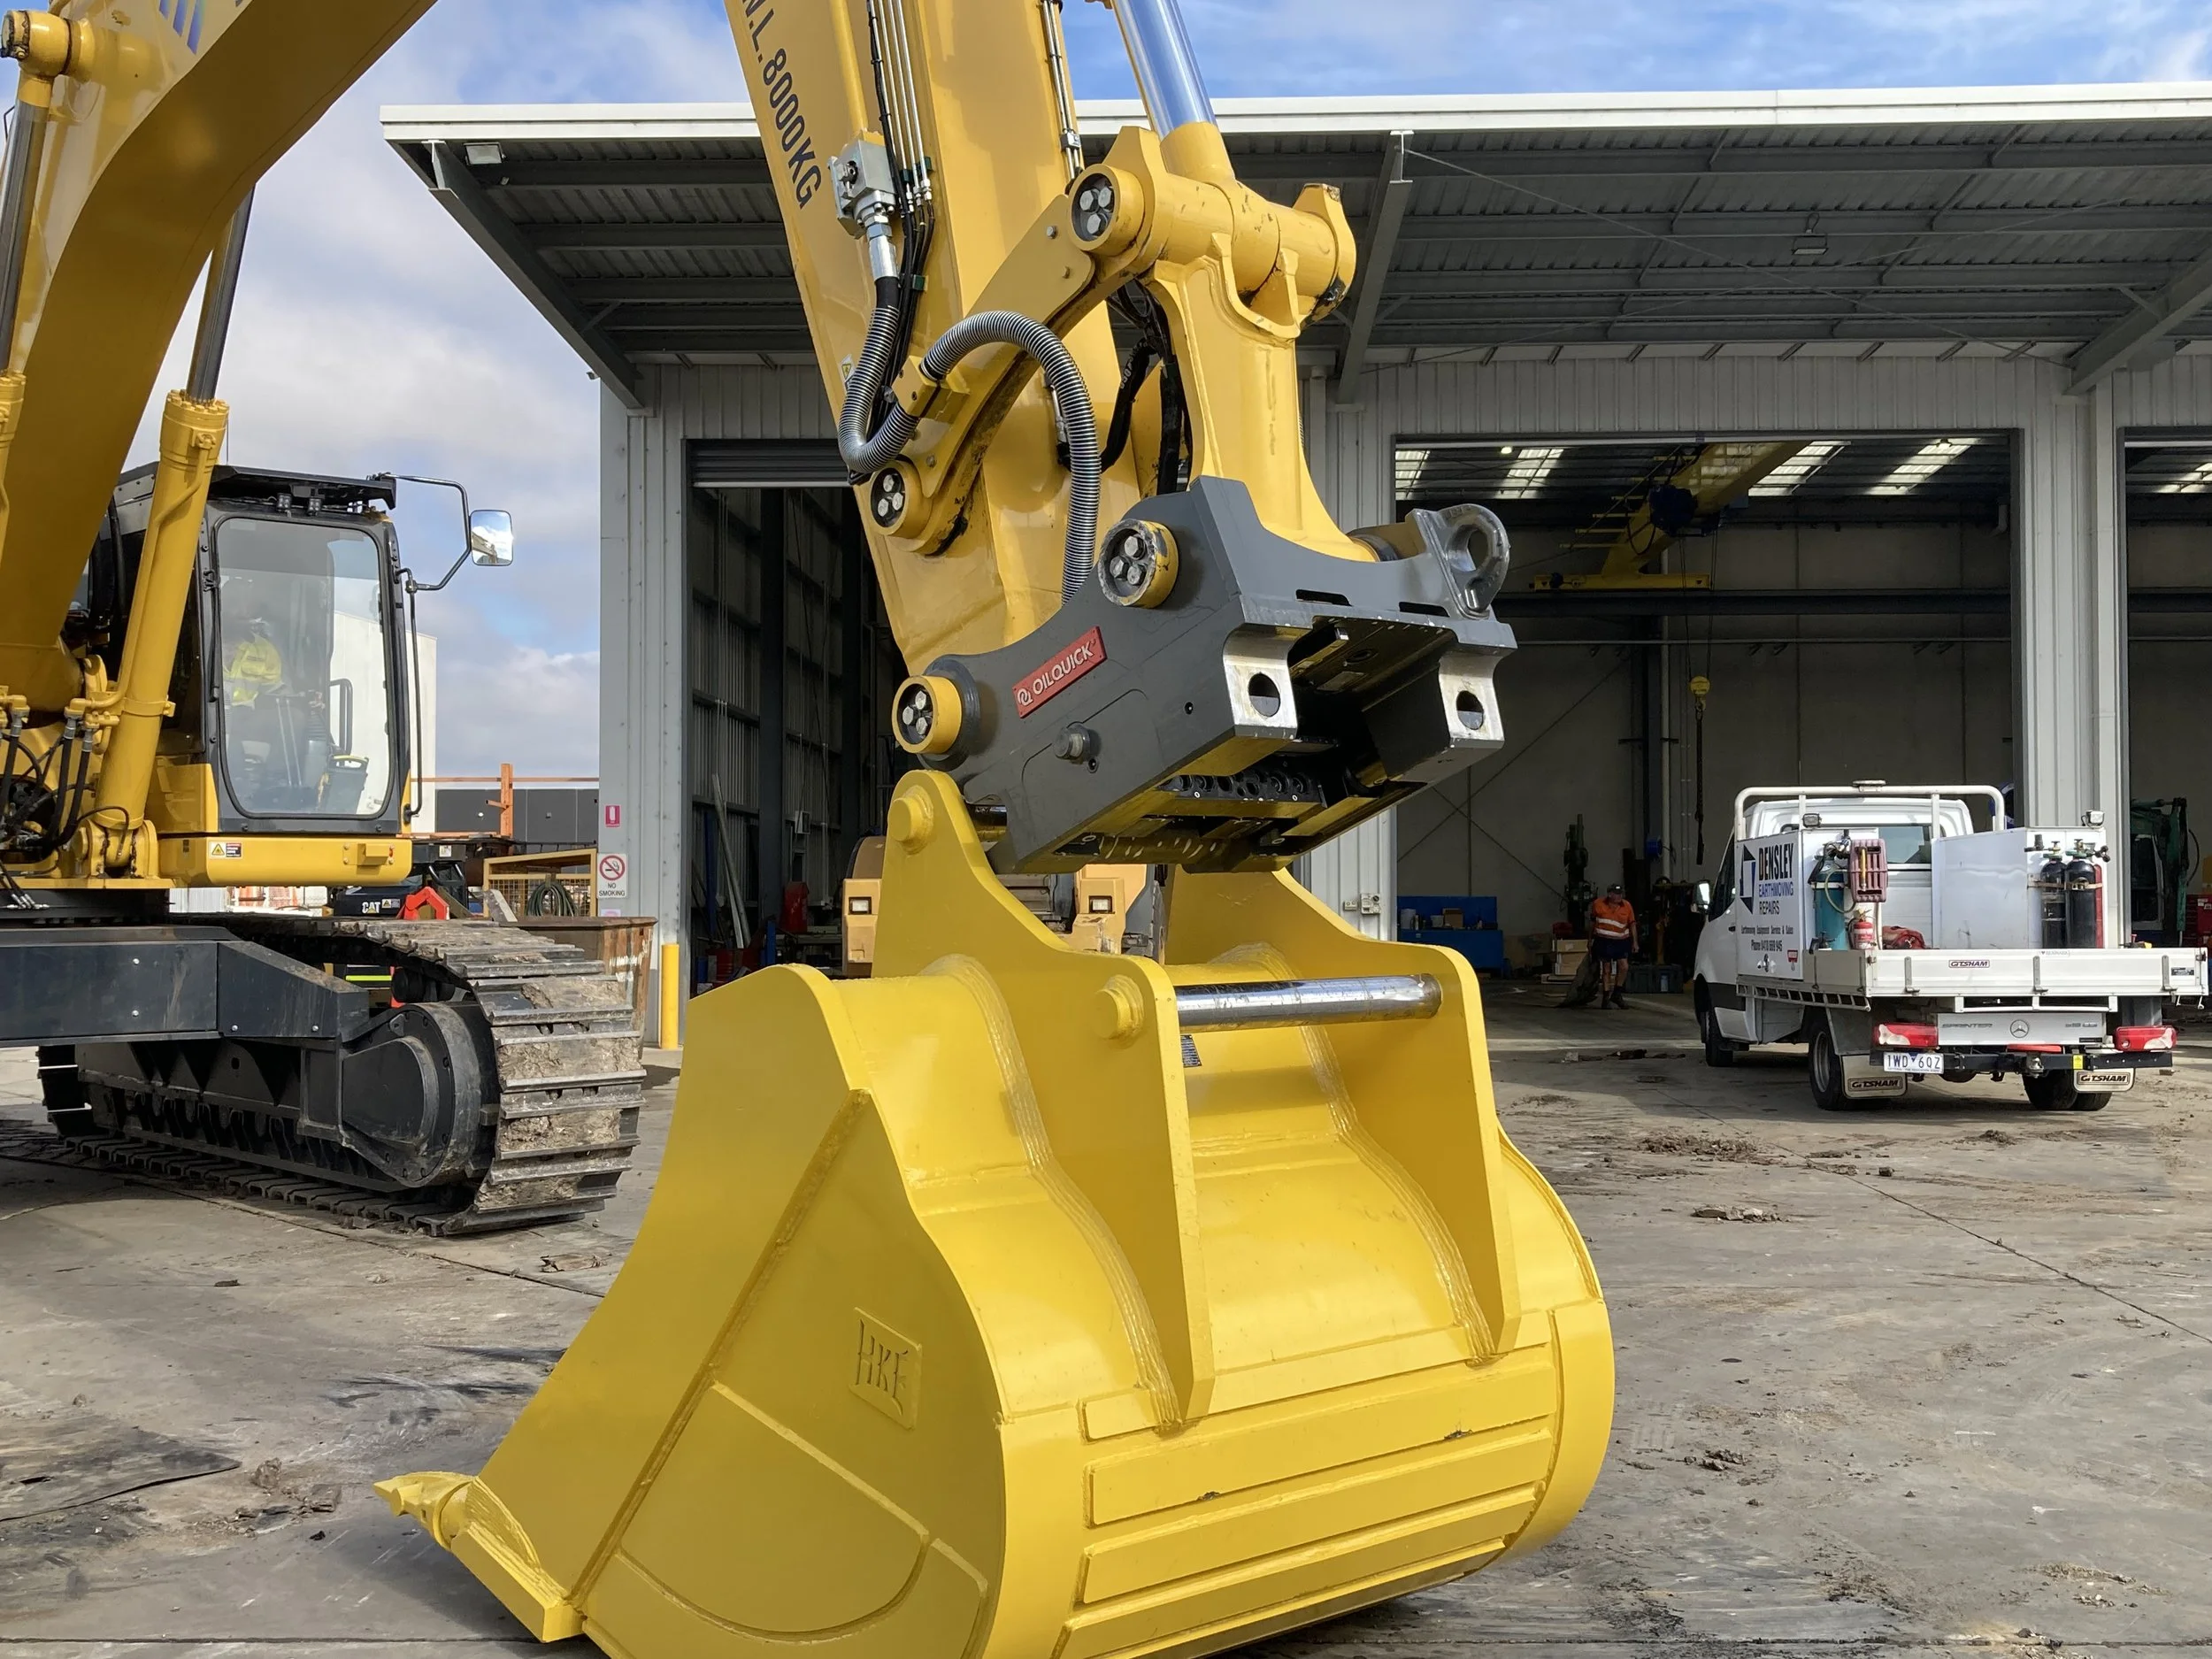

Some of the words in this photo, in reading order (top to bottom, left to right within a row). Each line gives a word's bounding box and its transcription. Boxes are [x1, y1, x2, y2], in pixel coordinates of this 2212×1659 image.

[1032, 641, 1094, 695] OILQUICK
[1758, 843, 1793, 881] DENSLEY
[1759, 882, 1793, 897] EARTHMOVING
[362, 902, 380, 914] CAT
[1759, 900, 1780, 915] REPAIRS
[1887, 1055, 1909, 1068] 1WD
